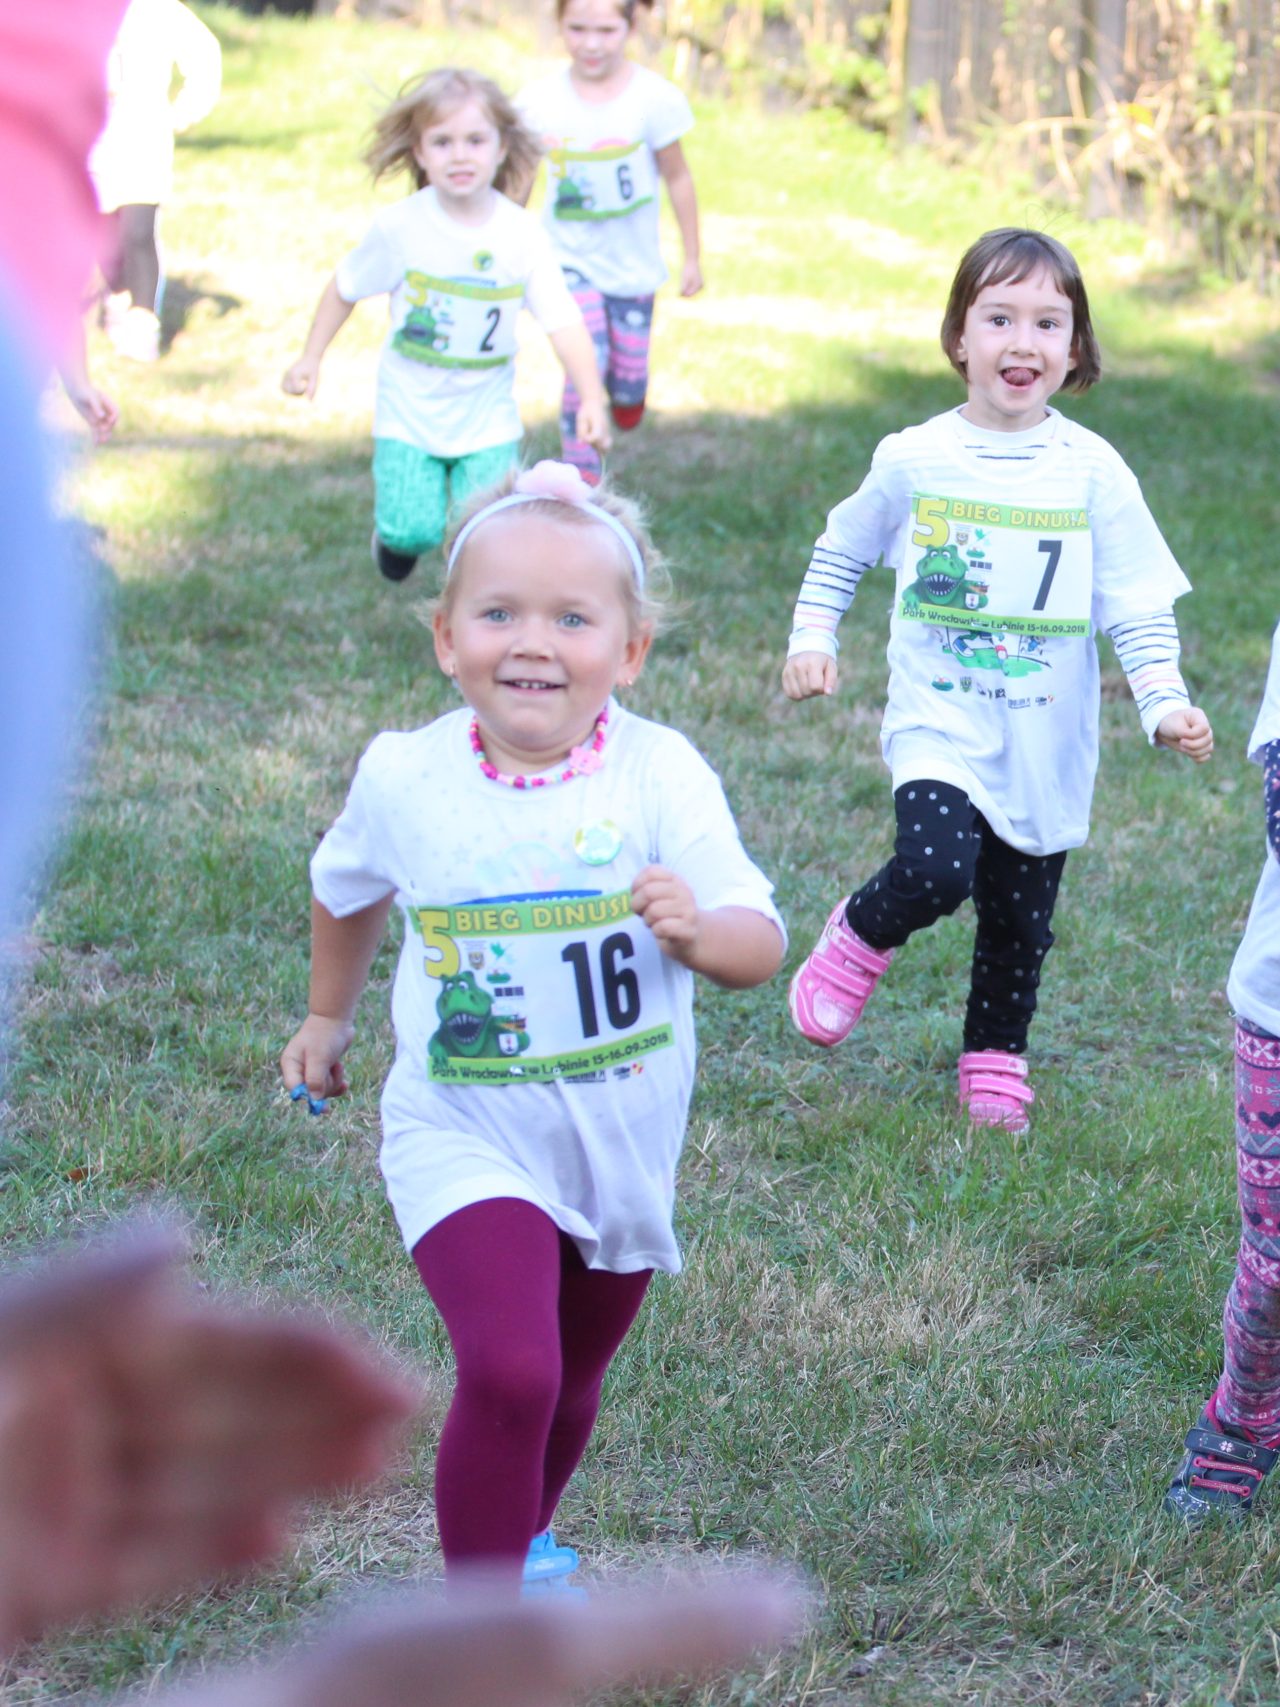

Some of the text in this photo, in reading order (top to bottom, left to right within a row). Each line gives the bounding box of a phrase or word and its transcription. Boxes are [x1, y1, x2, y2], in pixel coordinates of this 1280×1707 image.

[617, 164, 633, 200] 6
[480, 306, 501, 352] 2
[912, 497, 950, 548] 5
[952, 502, 1000, 523] BIEG
[1032, 539, 1063, 611] 7
[903, 608, 925, 618] Park
[1027, 623, 1085, 633] 15-16.09.2018
[418, 893, 630, 979] 5 BIEG DINUSI
[561, 932, 641, 1039] 16
[592, 1032, 669, 1065] 15-16.09.2018
